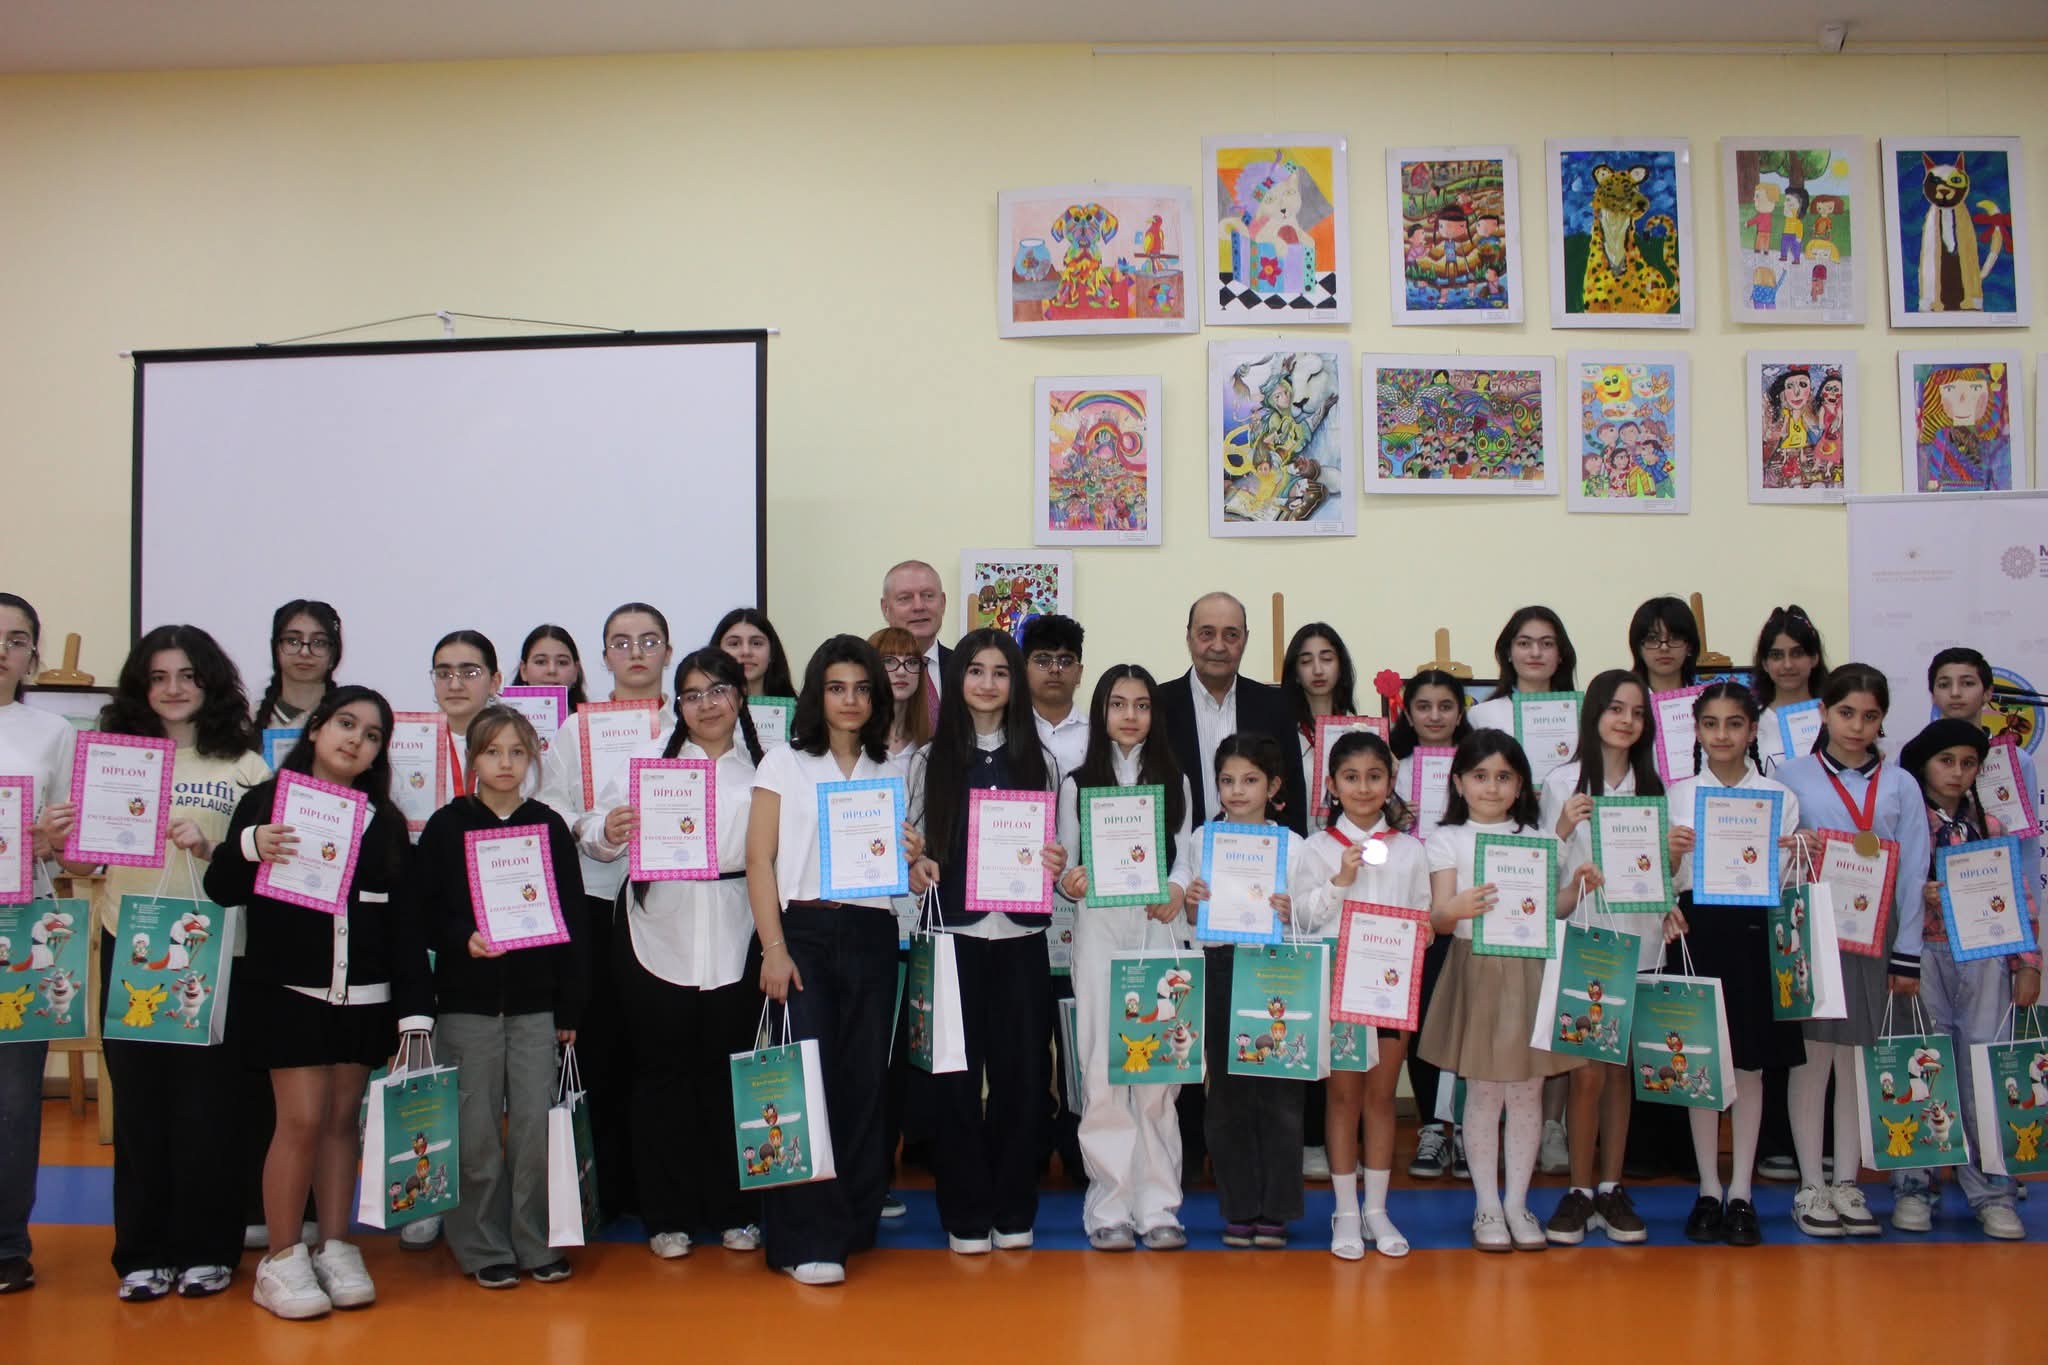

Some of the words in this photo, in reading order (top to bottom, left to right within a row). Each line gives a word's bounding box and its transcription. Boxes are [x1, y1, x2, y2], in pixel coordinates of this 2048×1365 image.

[526, 712, 547, 721] LOM
[755, 722, 775, 730] LOM
[391, 741, 424, 750] İPLOM
[175, 780, 235, 801] outfit
[176, 796, 234, 816] APPLAUSE
